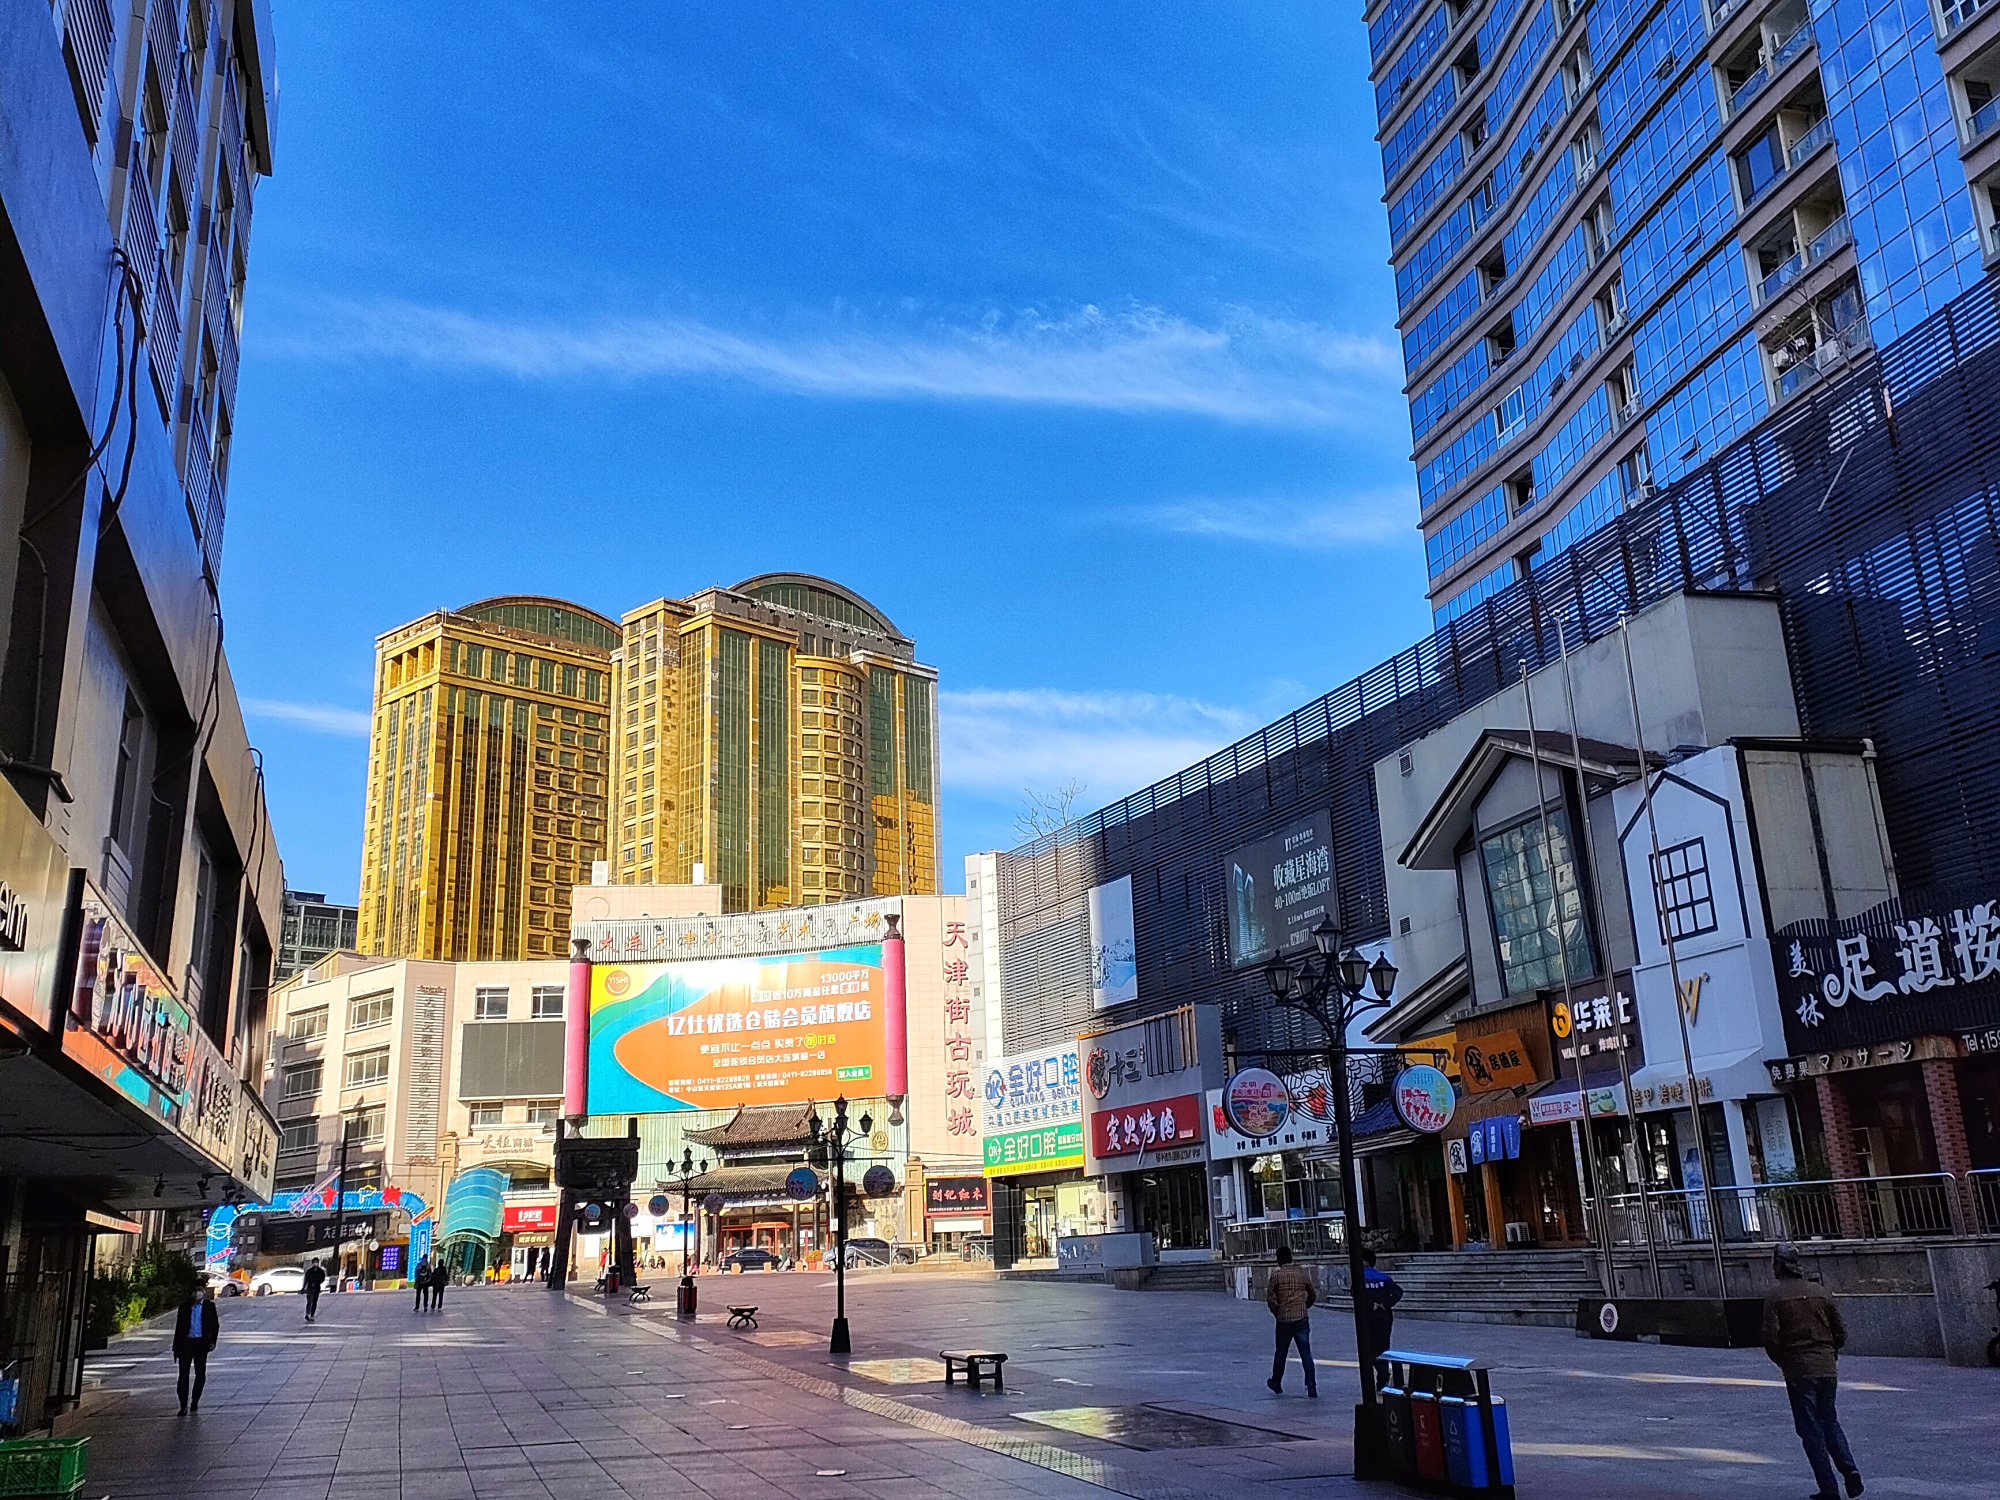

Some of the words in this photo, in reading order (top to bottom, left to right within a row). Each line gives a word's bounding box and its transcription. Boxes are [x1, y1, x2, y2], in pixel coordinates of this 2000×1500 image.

[1273, 845, 1330, 891] 收藏星海湾
[608, 976, 629, 984] YISHI
[820, 969, 870, 984] 13000平方
[667, 1001, 871, 1036] 亿仕优选仓储会员旗舰店
[942, 920, 977, 1137] 天津街古玩城
[699, 1039, 771, 1055] 便宜不止一点点
[1488, 1049, 1521, 1071] 居酒屋
[1819, 1041, 1912, 1070] マッサージ
[1009, 1052, 1079, 1098] 全好口腔
[1003, 1130, 1057, 1162] 全好口腔
[1106, 1106, 1176, 1166] 炭火烤肉
[932, 1187, 984, 1203] 刘记红木
